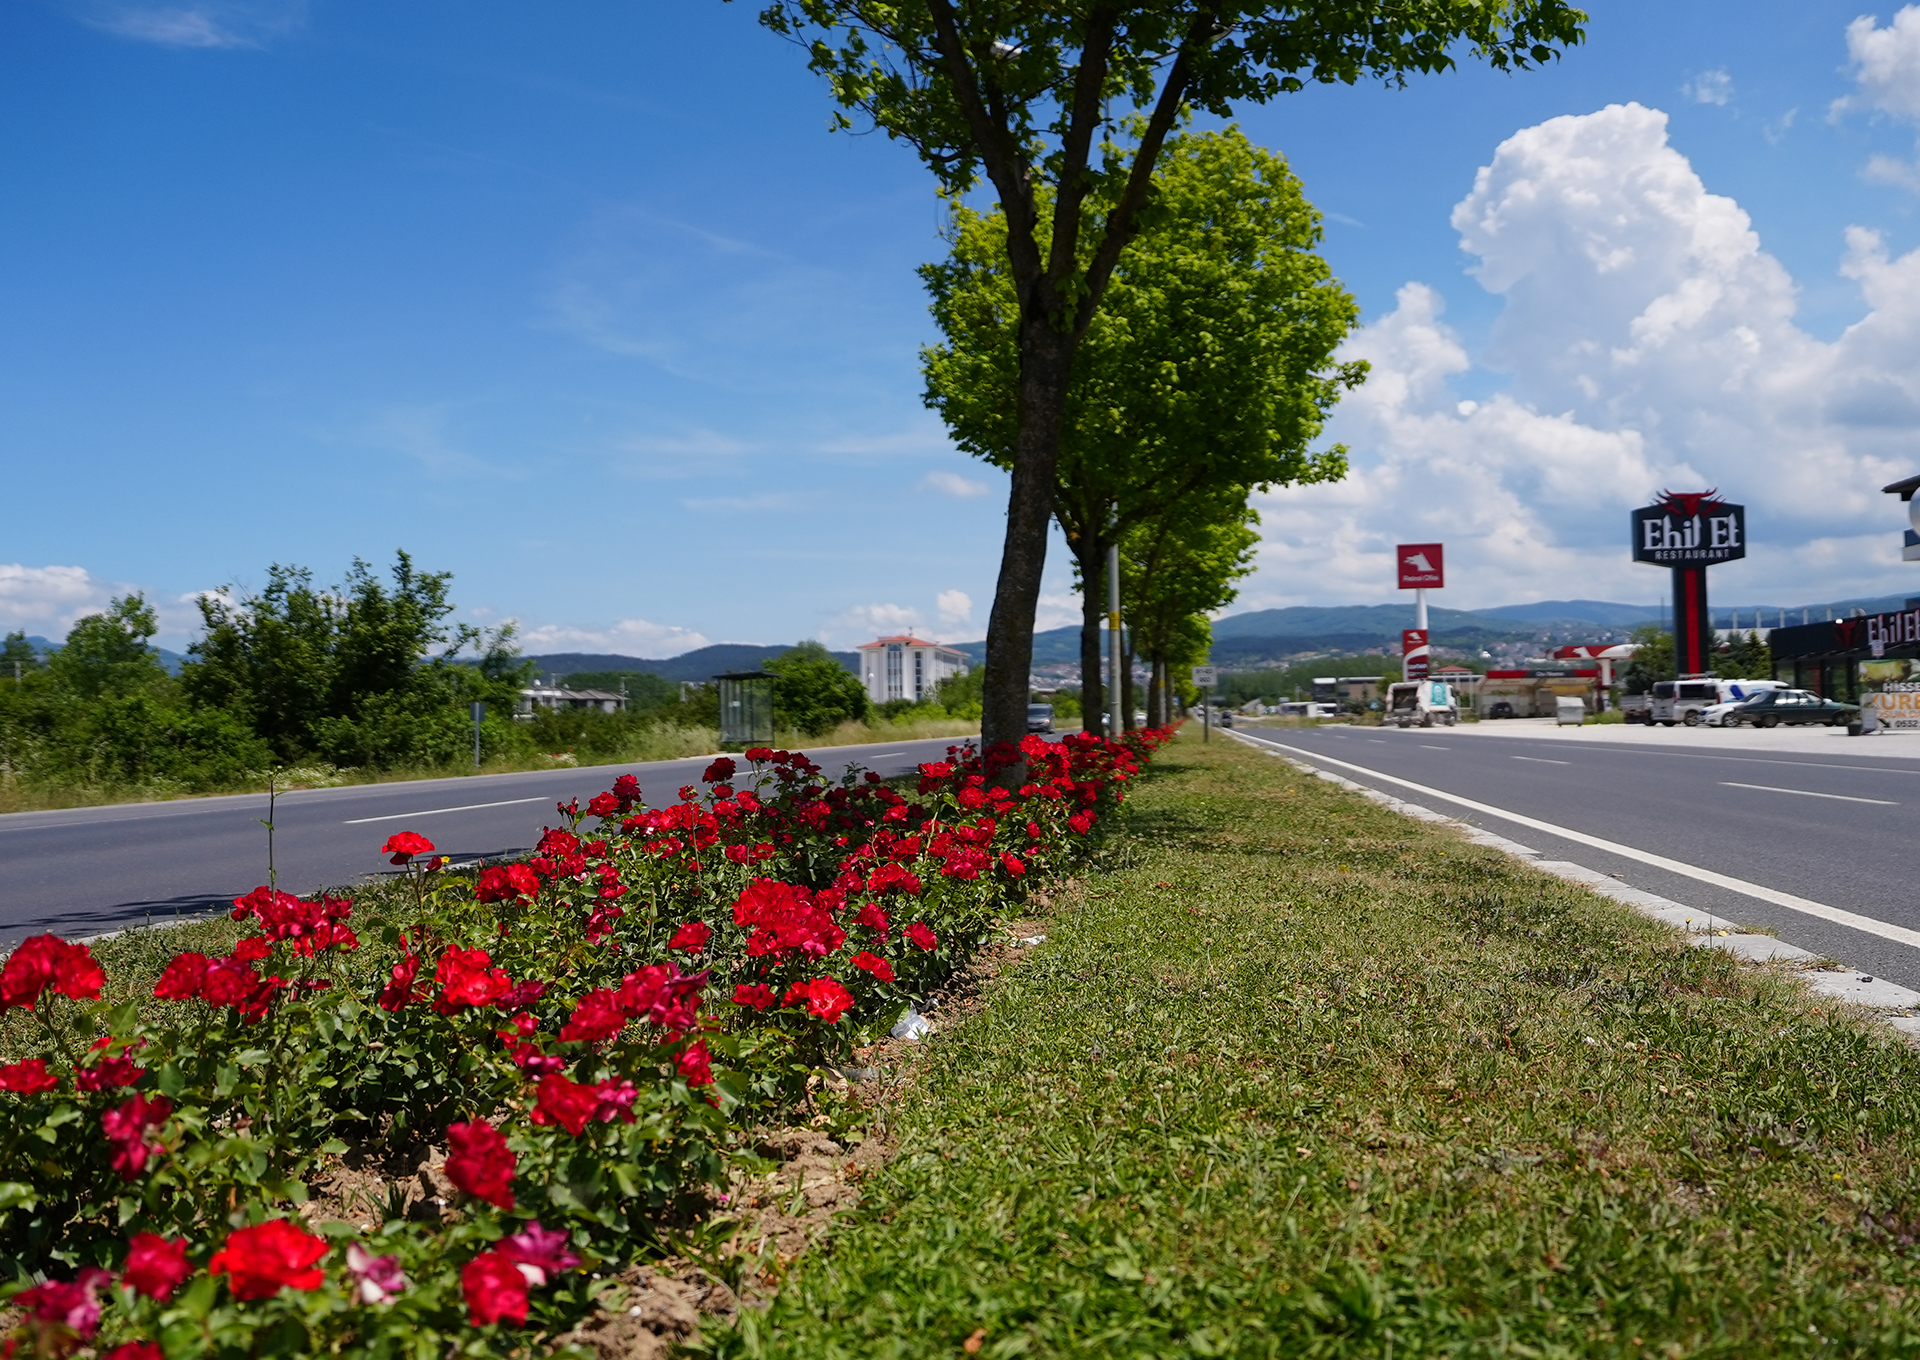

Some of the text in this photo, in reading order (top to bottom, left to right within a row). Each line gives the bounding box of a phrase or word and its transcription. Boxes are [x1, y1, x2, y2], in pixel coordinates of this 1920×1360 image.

[1642, 512, 1741, 550] Ehil Et
[1655, 549, 1730, 560] RESTAURANT
[1867, 612, 1902, 646] Ehil
